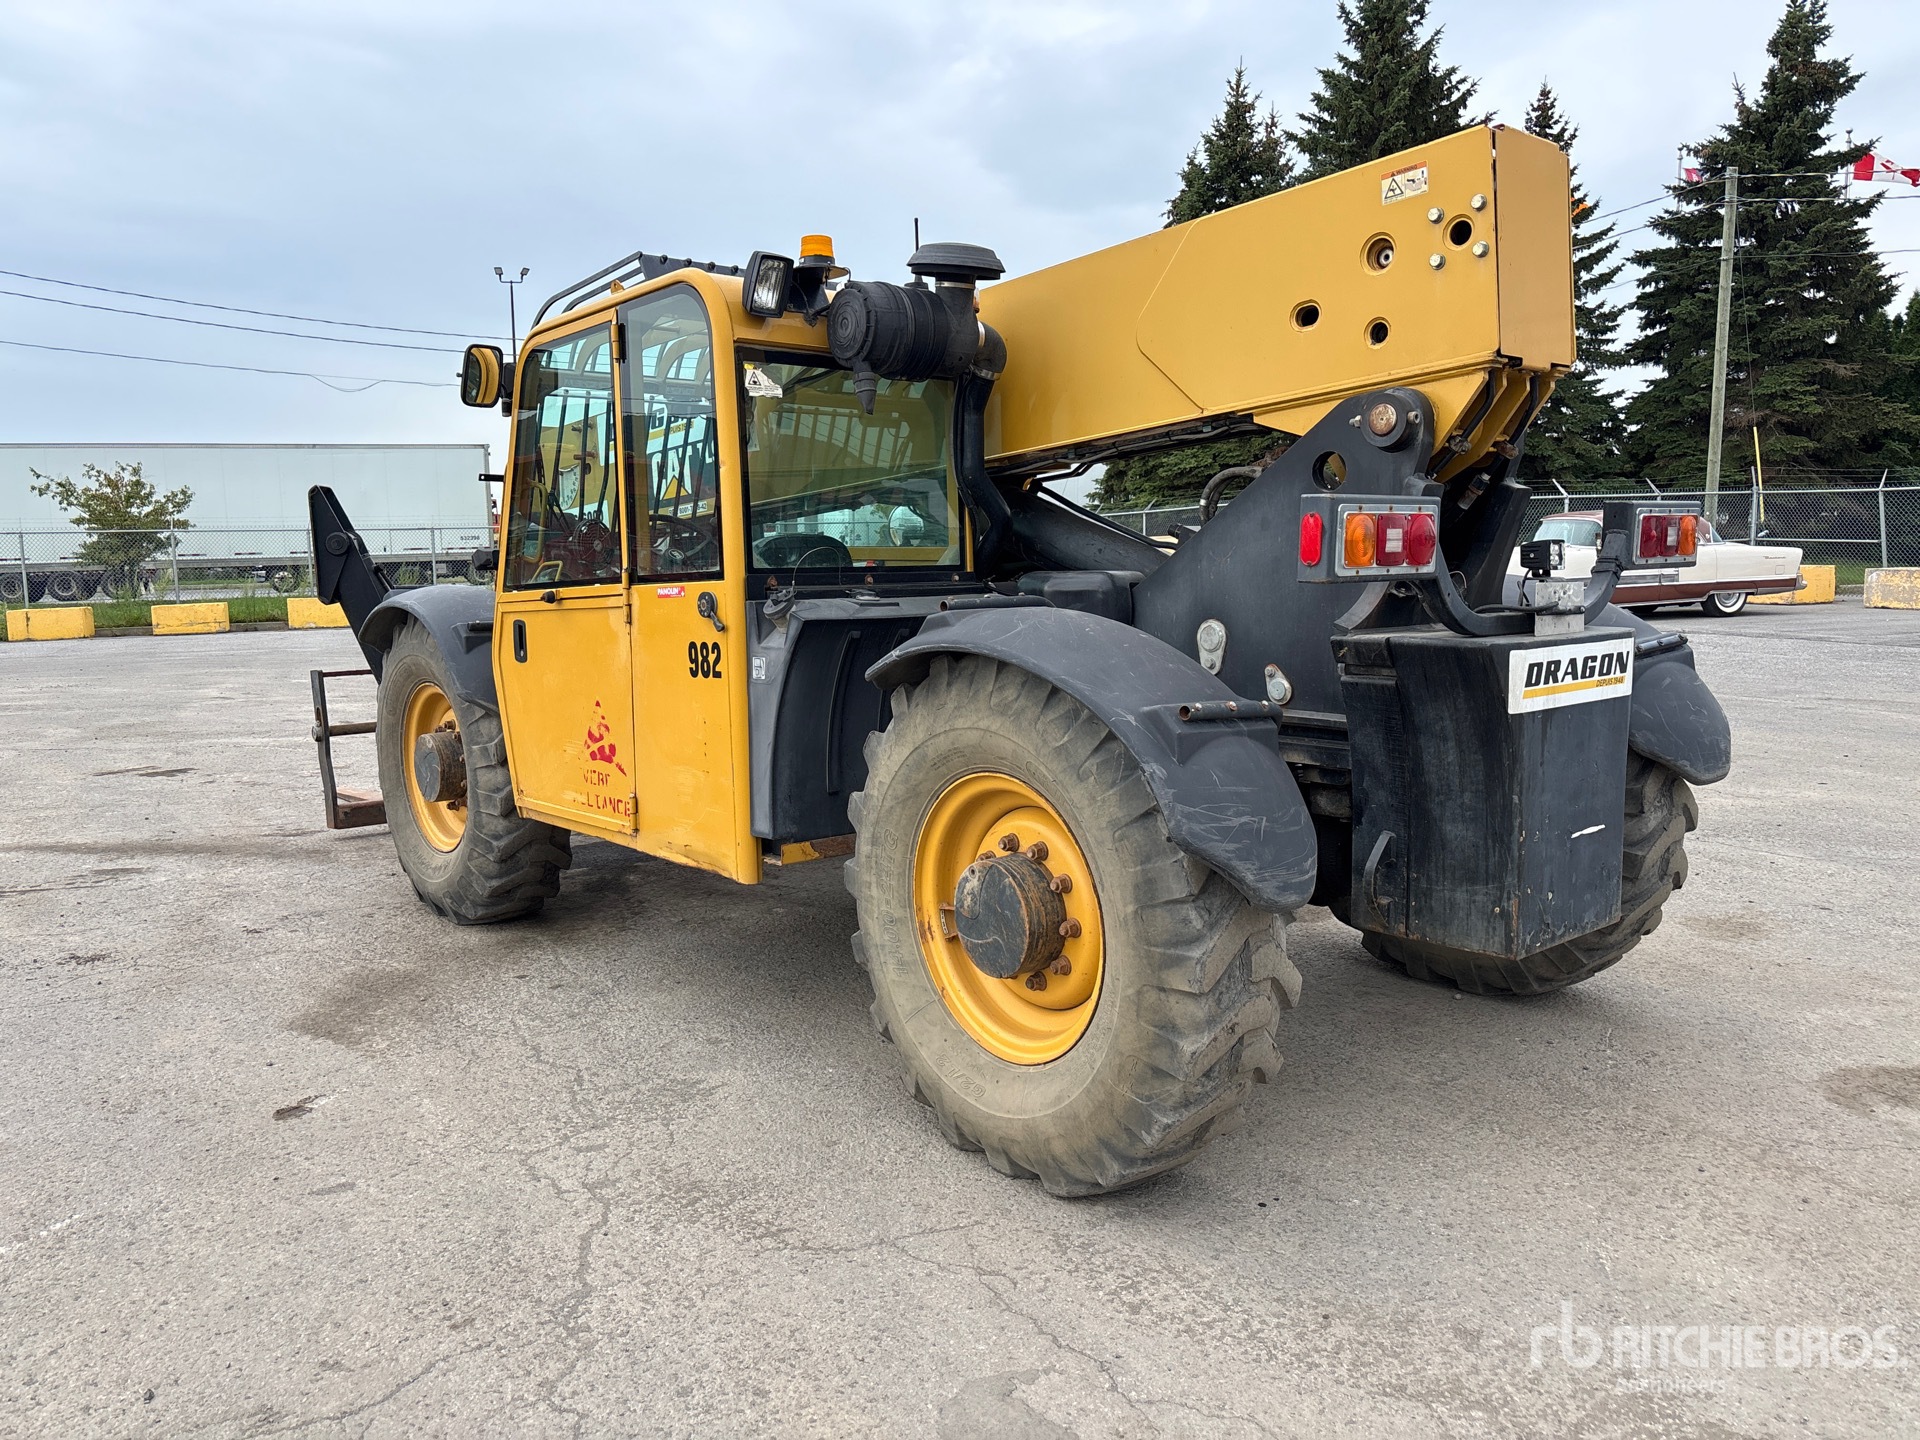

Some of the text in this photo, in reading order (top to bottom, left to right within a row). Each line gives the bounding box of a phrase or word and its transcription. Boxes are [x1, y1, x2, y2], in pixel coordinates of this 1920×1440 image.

[1396, 164, 1418, 175] WARNING
[688, 641, 722, 679] 982
[1525, 651, 1630, 688] DRAGON
[1596, 678, 1613, 687] DEPUIS
